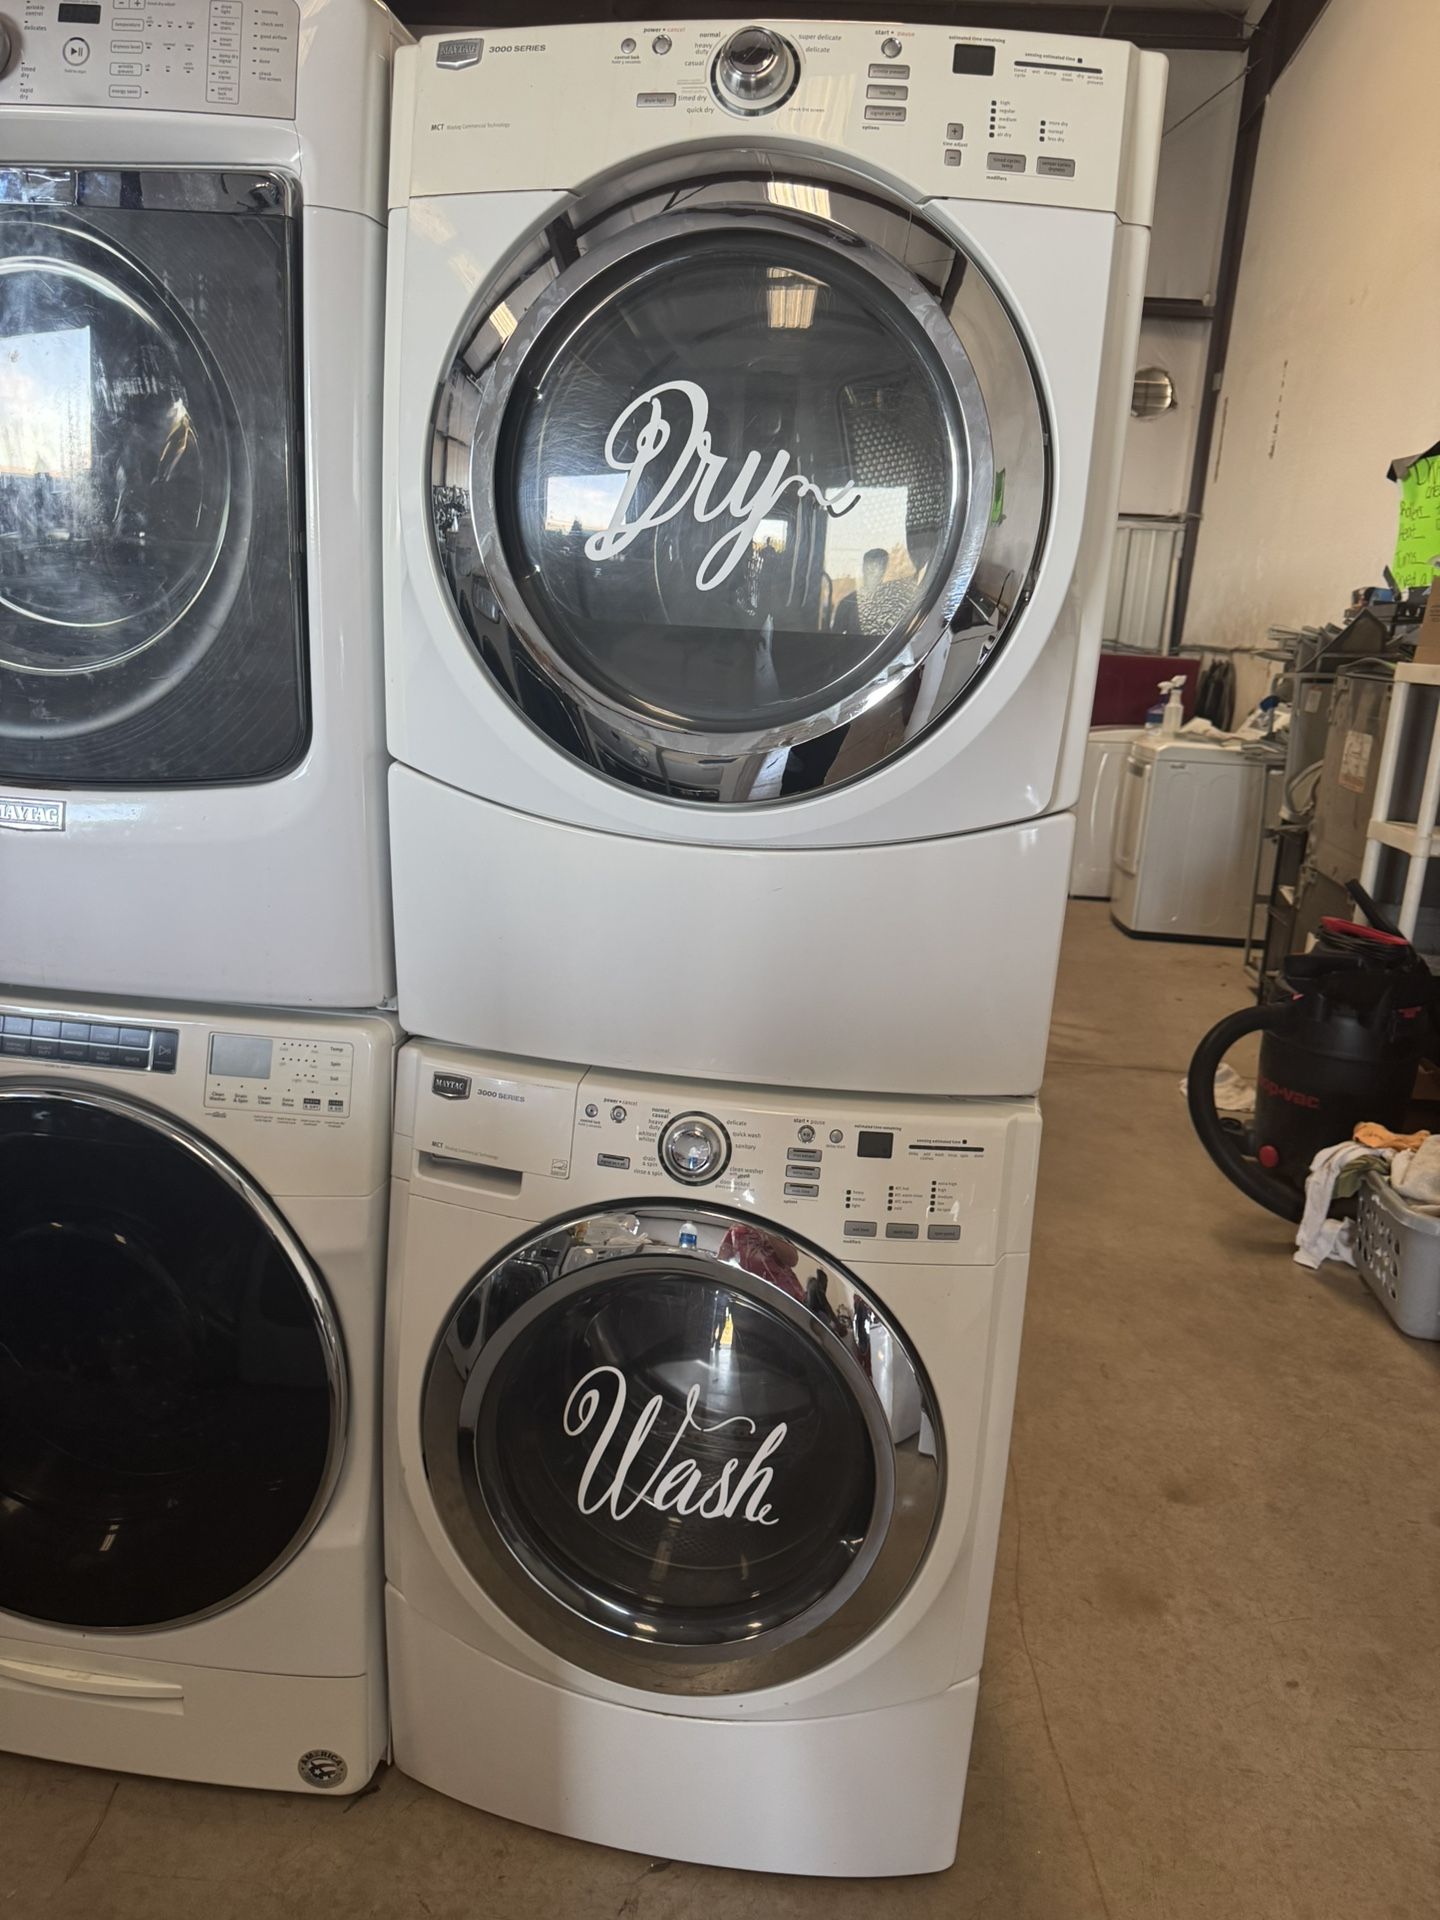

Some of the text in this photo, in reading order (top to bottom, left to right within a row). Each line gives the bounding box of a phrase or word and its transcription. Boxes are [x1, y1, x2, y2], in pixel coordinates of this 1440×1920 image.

[799, 33, 842, 41] super delicate
[514, 44, 546, 52] SERIES
[694, 42, 712, 50] heavy
[678, 94, 707, 103] timed dry
[687, 106, 715, 114] quick dry
[431, 123, 445, 131] MCT
[584, 380, 855, 591] Dry
[436, 1078, 465, 1091] MAYTAG
[477, 1088, 525, 1103] 3000 SERIES
[649, 1118, 664, 1126] heavy
[563, 1365, 788, 1526] Wash
